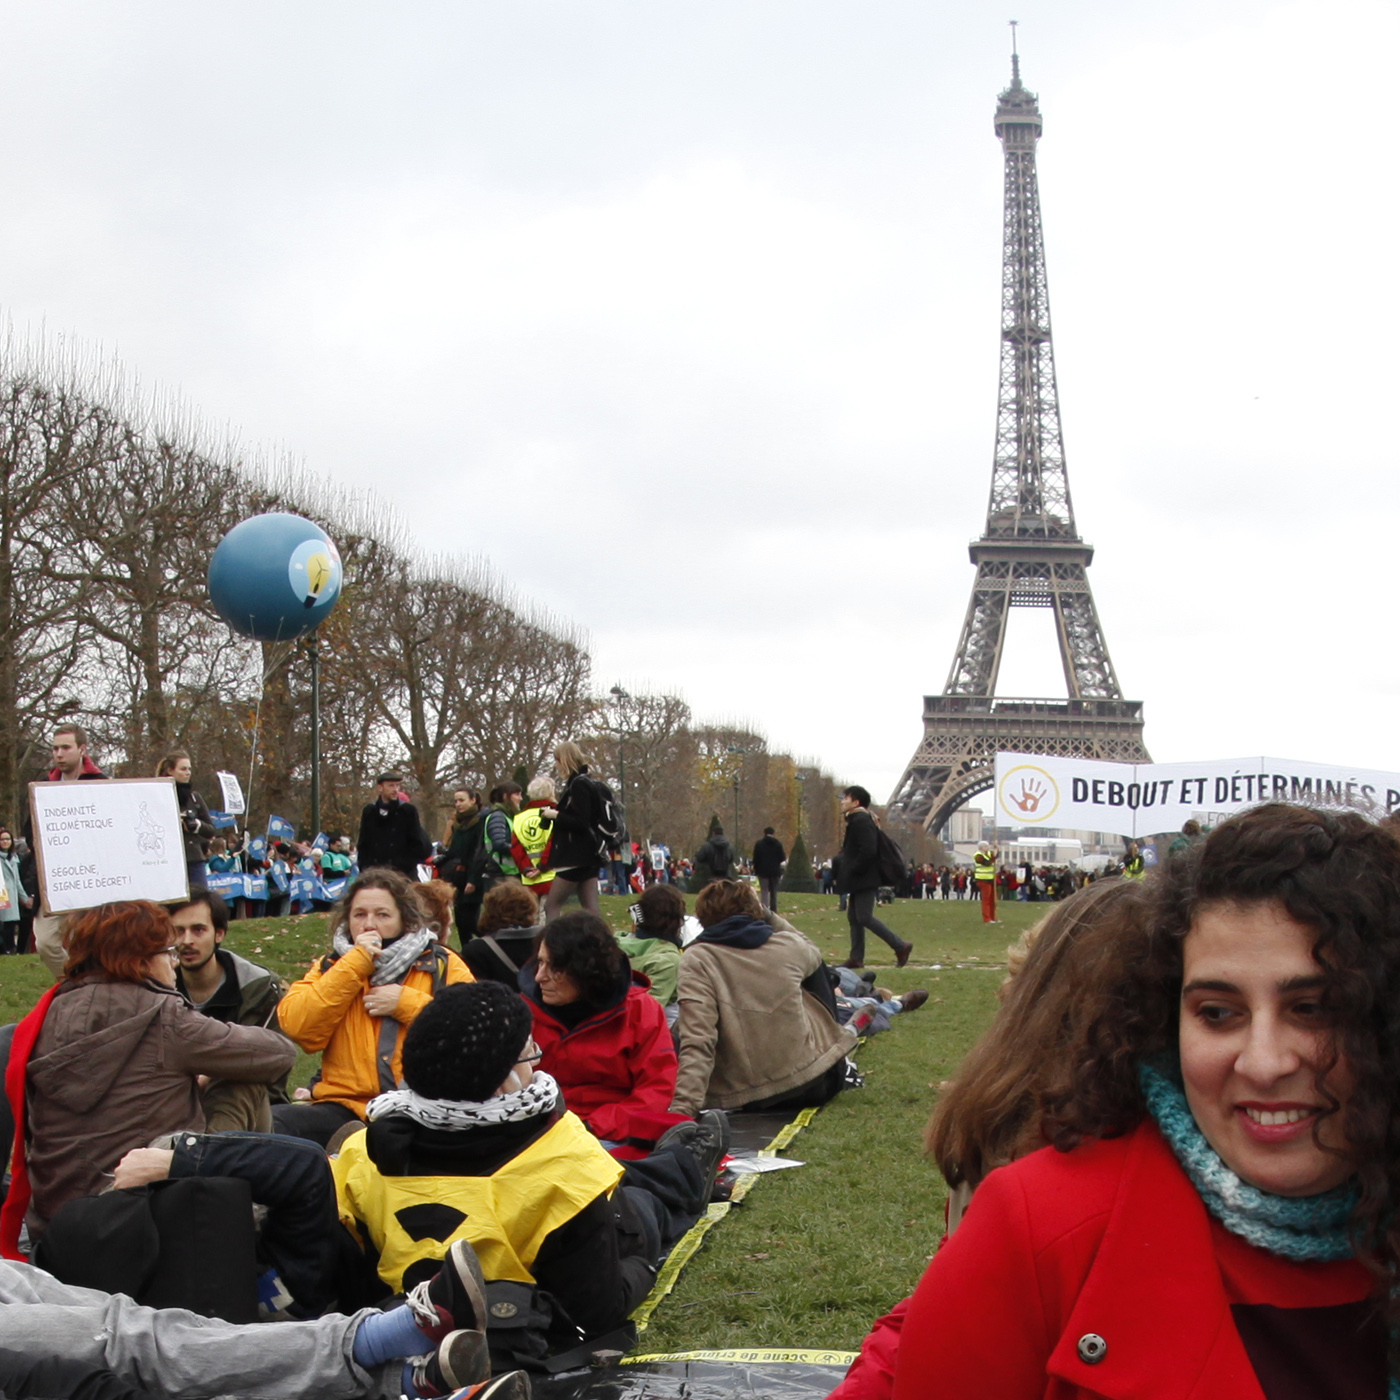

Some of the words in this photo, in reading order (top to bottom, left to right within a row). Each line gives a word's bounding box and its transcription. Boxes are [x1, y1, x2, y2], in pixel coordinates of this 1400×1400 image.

[1071, 777, 1174, 810] DEBOUT
[1179, 777, 1208, 804] ET
[1214, 770, 1377, 810] DÉTERMINÉS
[44, 804, 97, 818] INDEMNITÉ
[46, 818, 114, 832] KILOMÉTRIQUE
[47, 833, 71, 846] VÉLO
[52, 879, 81, 892] SIGNE
[83, 878, 93, 889] LE
[95, 874, 127, 888] DÉCRET
